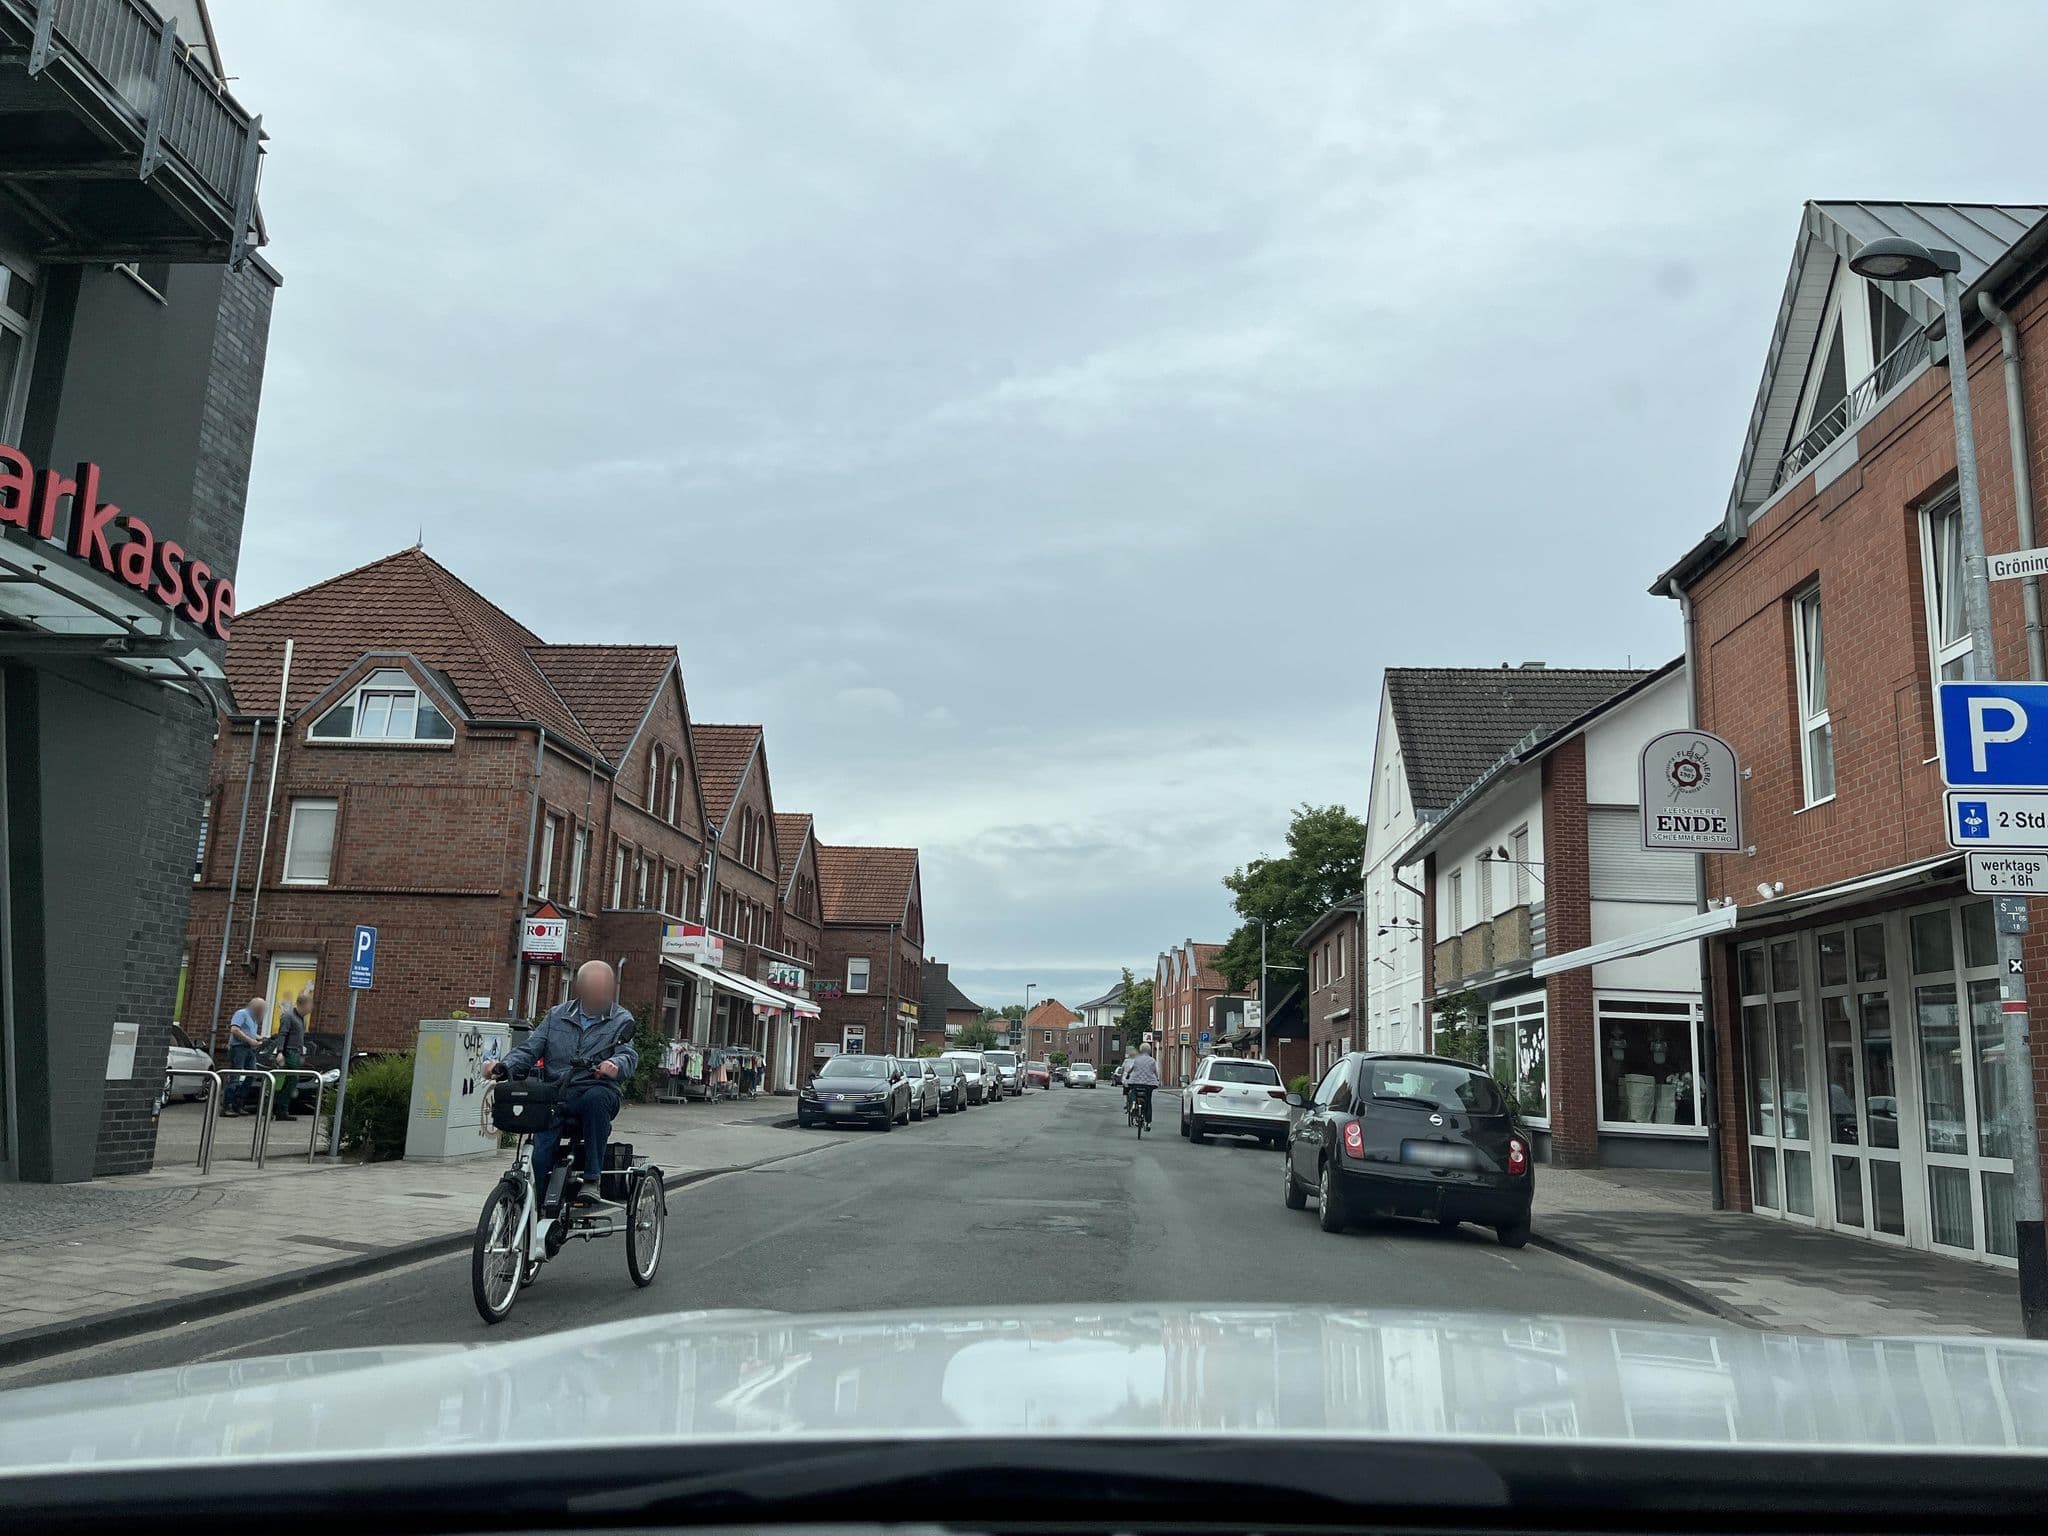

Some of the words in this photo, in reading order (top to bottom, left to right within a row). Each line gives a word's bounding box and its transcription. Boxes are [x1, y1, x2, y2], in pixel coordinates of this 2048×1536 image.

[0, 444, 236, 642] arkasse
[1967, 697, 2028, 773] P
[1663, 807, 1720, 815] FLEISCHEREI
[1656, 816, 1727, 833] ENDE
[1999, 812, 2009, 827] 2
[1652, 833, 1700, 841] SCHLEMMER
[1703, 834, 1732, 843] BISTRO
[1981, 859, 2040, 874] werktags
[1990, 874, 1997, 886] 8
[2010, 875, 2033, 887] 18h
[2000, 902, 2007, 912] S
[357, 931, 371, 962] P
[1202, 1033, 1209, 1041] P
